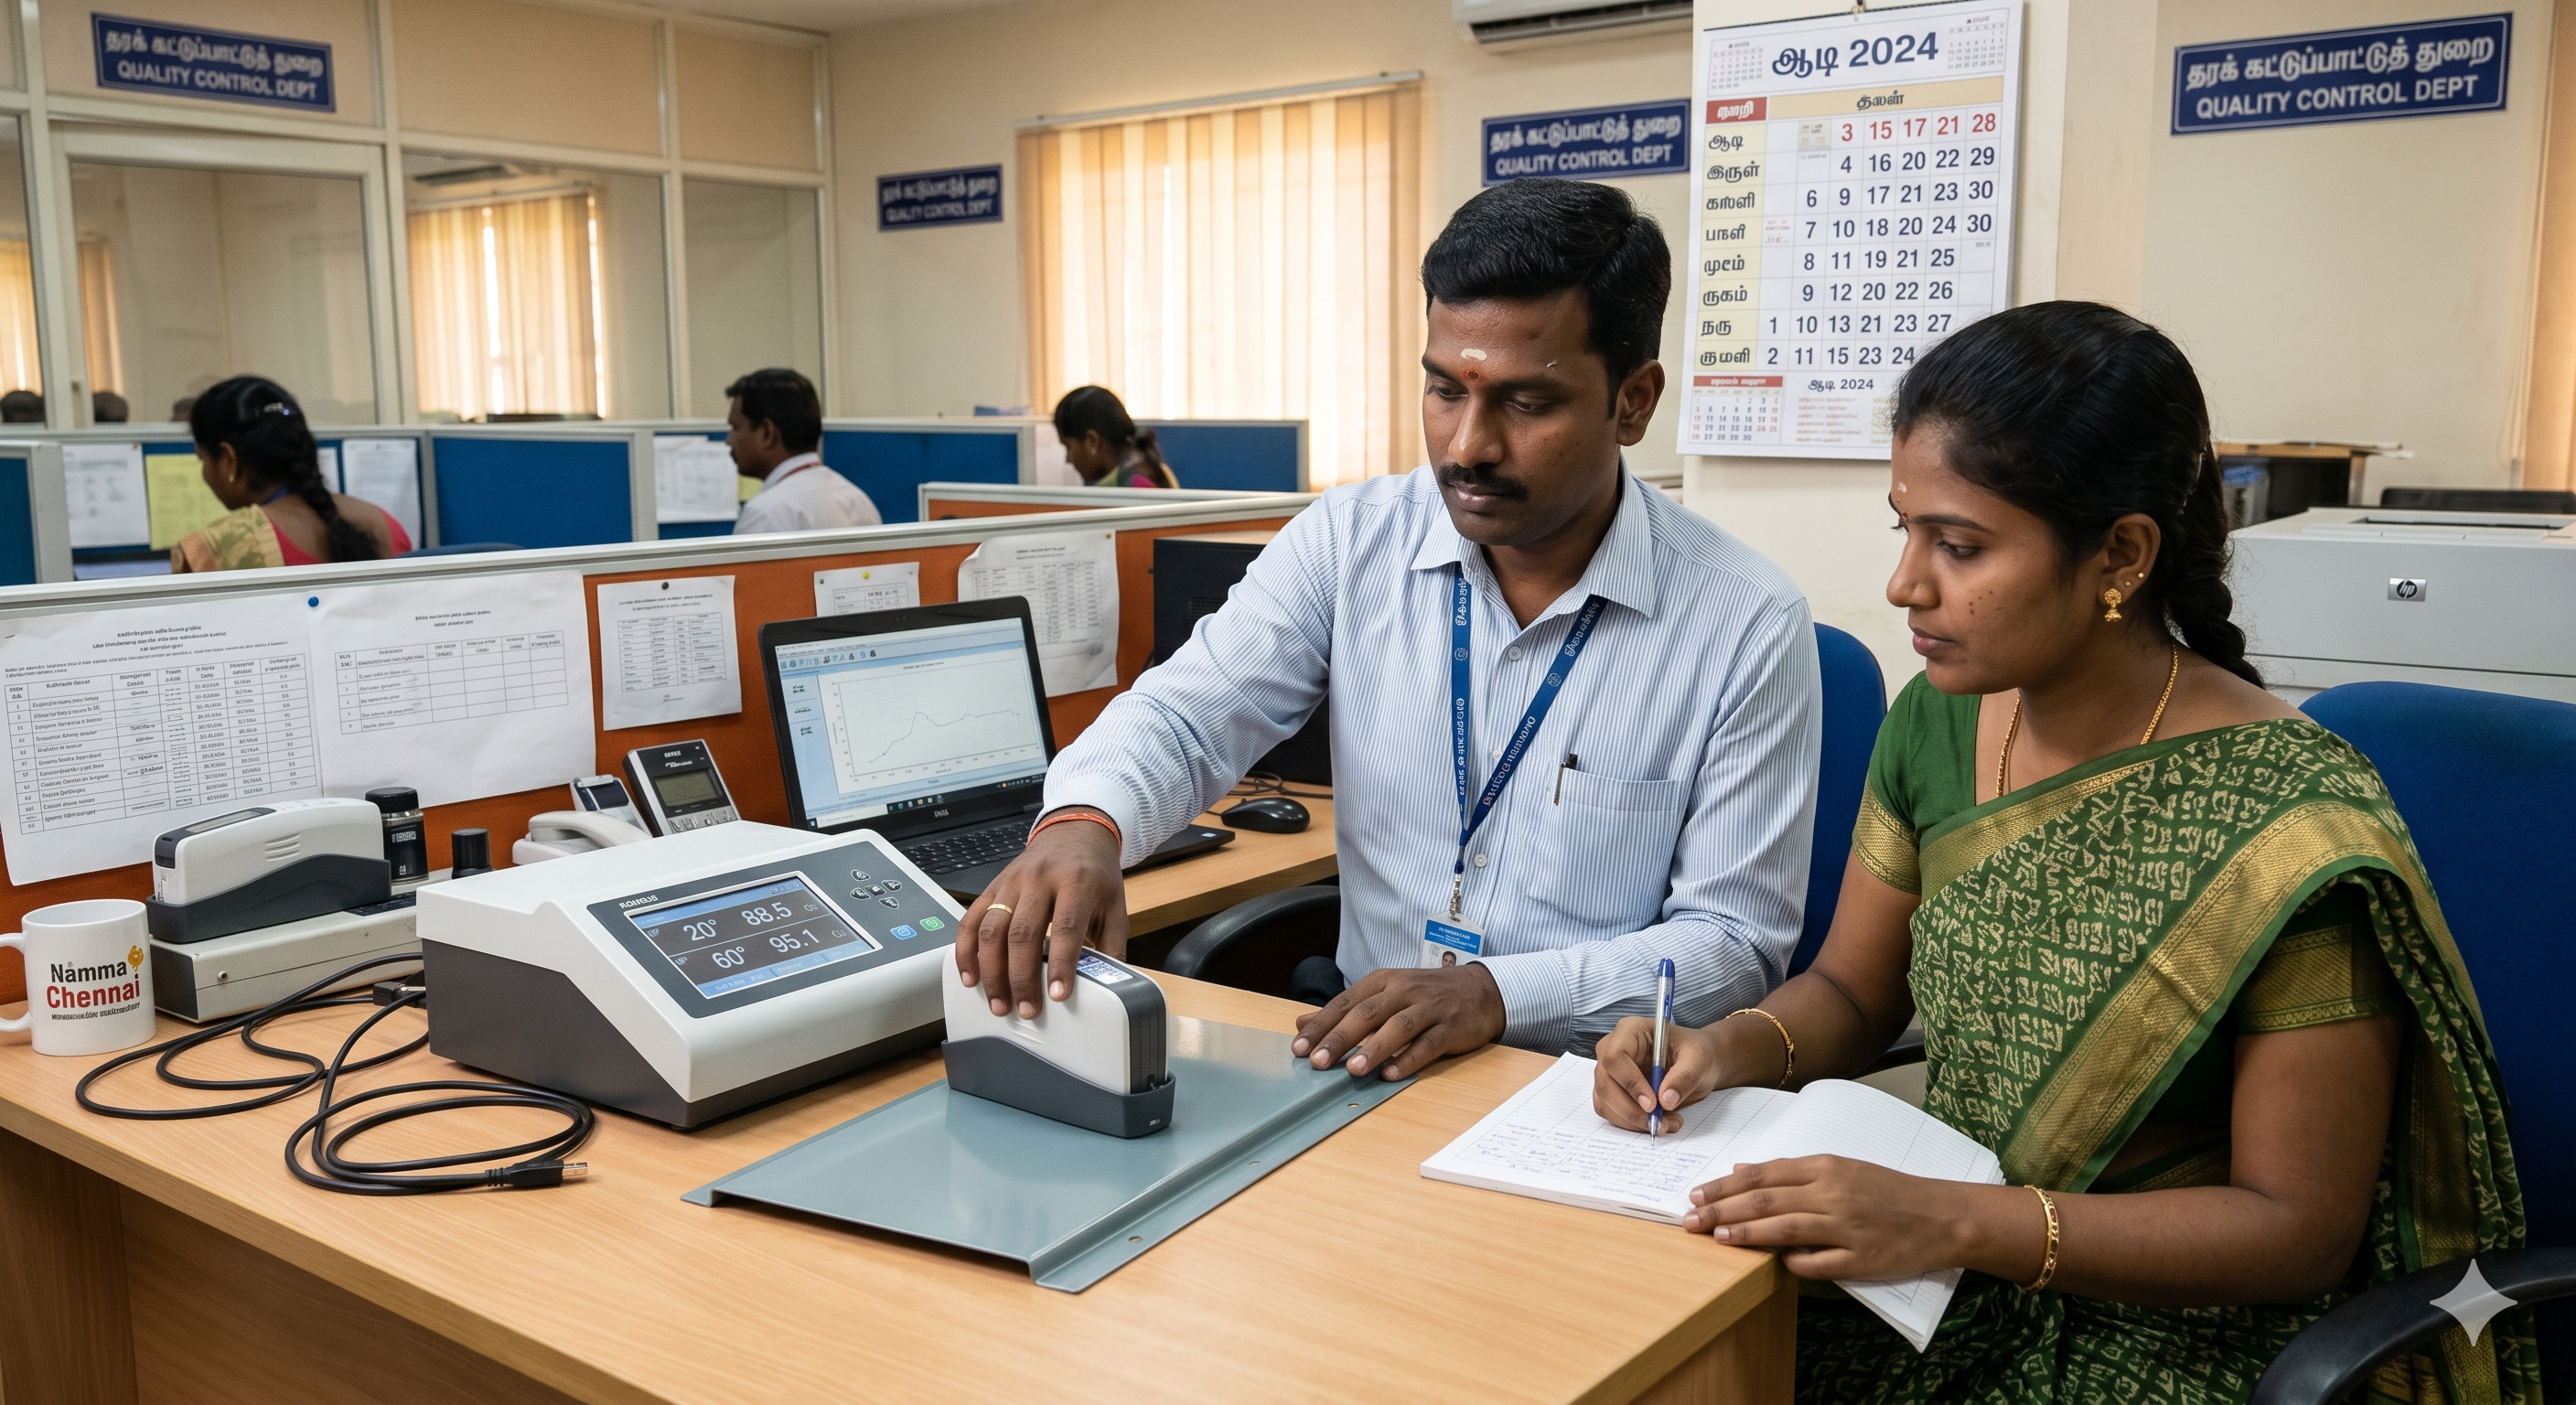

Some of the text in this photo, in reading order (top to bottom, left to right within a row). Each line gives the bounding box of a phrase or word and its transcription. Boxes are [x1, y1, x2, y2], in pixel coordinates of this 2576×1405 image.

[1772, 47, 1839, 78] ஆடி
[1849, 32, 1938, 67] 2024
[2185, 36, 2495, 91] தரக் கட்டுப்பாட்டுத் துறை
[117, 59, 317, 100] QUALITY CONTROL DEPT
[2196, 75, 2478, 120] QUALITY CONTROL DEPT
[1841, 113, 1996, 141] 3 15 17 21 28
[1709, 135, 1744, 152] ஆடி
[1496, 144, 1672, 176] QUALITY CONTROL DEPT
[1707, 161, 1760, 183] இருள்
[1841, 146, 1994, 173] 4 16 20 22 29
[1807, 180, 1993, 207] 6 9 17 21 23 30
[1806, 221, 1817, 239] 7
[1833, 220, 1855, 238] 10
[1866, 218, 1888, 236] 18
[1899, 217, 1923, 235] 20
[1932, 215, 1956, 234] 24
[1967, 214, 1991, 232] 30
[1804, 249, 1955, 270] 8 11 19 21 25
[1803, 281, 1953, 301] 9 12 20 22 26
[1770, 314, 1951, 334] 1 10 13 21 23 27
[1767, 347, 1915, 364] 2 11 15 23 24
[1841, 379, 1873, 390] 2024
[2397, 579, 2417, 598] hp
[682, 918, 718, 941] 20°
[741, 901, 792, 928] 88.5
[712, 945, 746, 969] 60°
[768, 928, 820, 953] 95.1
[47, 973, 140, 1009] Chennai
